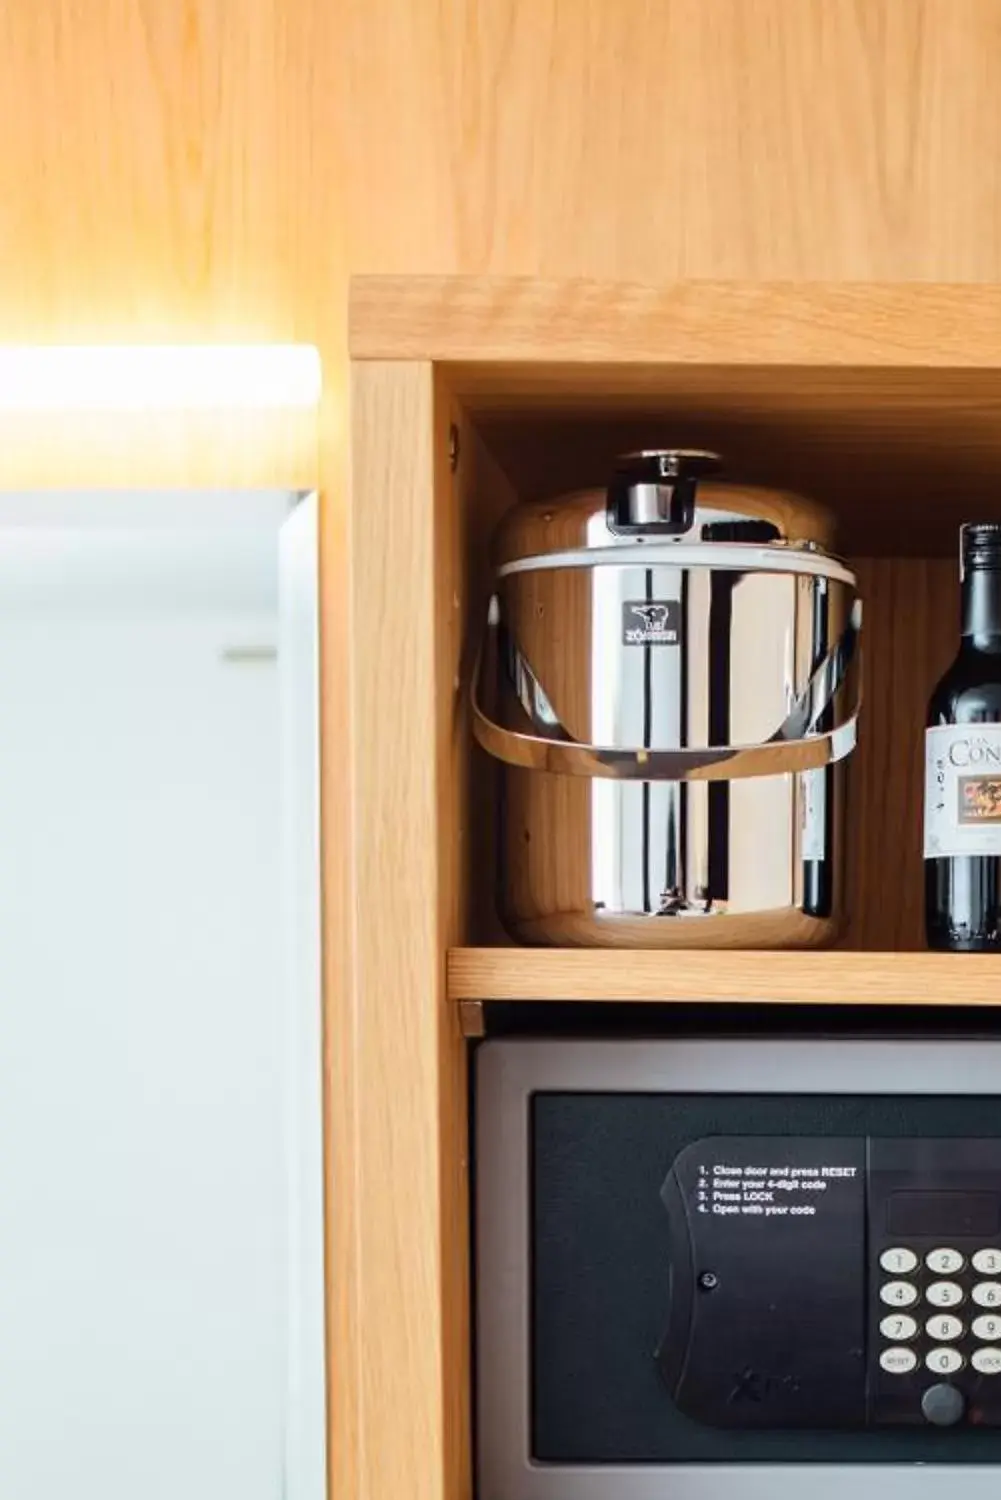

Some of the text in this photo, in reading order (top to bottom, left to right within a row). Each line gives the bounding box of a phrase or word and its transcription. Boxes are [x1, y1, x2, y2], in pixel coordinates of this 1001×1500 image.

[699, 1166, 857, 1178] 1. Close door and press RESET
[698, 1179, 708, 1188] 2.
[713, 1179, 740, 1188] Enter
[742, 1180, 765, 1190] your
[801, 1180, 827, 1189] code
[713, 1192, 741, 1201] Press
[743, 1192, 774, 1201] LOCK
[713, 1205, 740, 1215] Open
[742, 1205, 763, 1214] with
[766, 1206, 788, 1216] your
[790, 1206, 816, 1215] code
[895, 1255, 903, 1267] 1
[941, 1255, 950, 1269] 2
[987, 1255, 995, 1269] 3
[895, 1288, 903, 1300] 4
[941, 1289, 950, 1302] 5
[987, 1288, 995, 1302] 6
[895, 1321, 903, 1335] 7
[941, 1322, 950, 1335] 8
[987, 1321, 995, 1335] 9
[939, 1355, 949, 1368] 0
